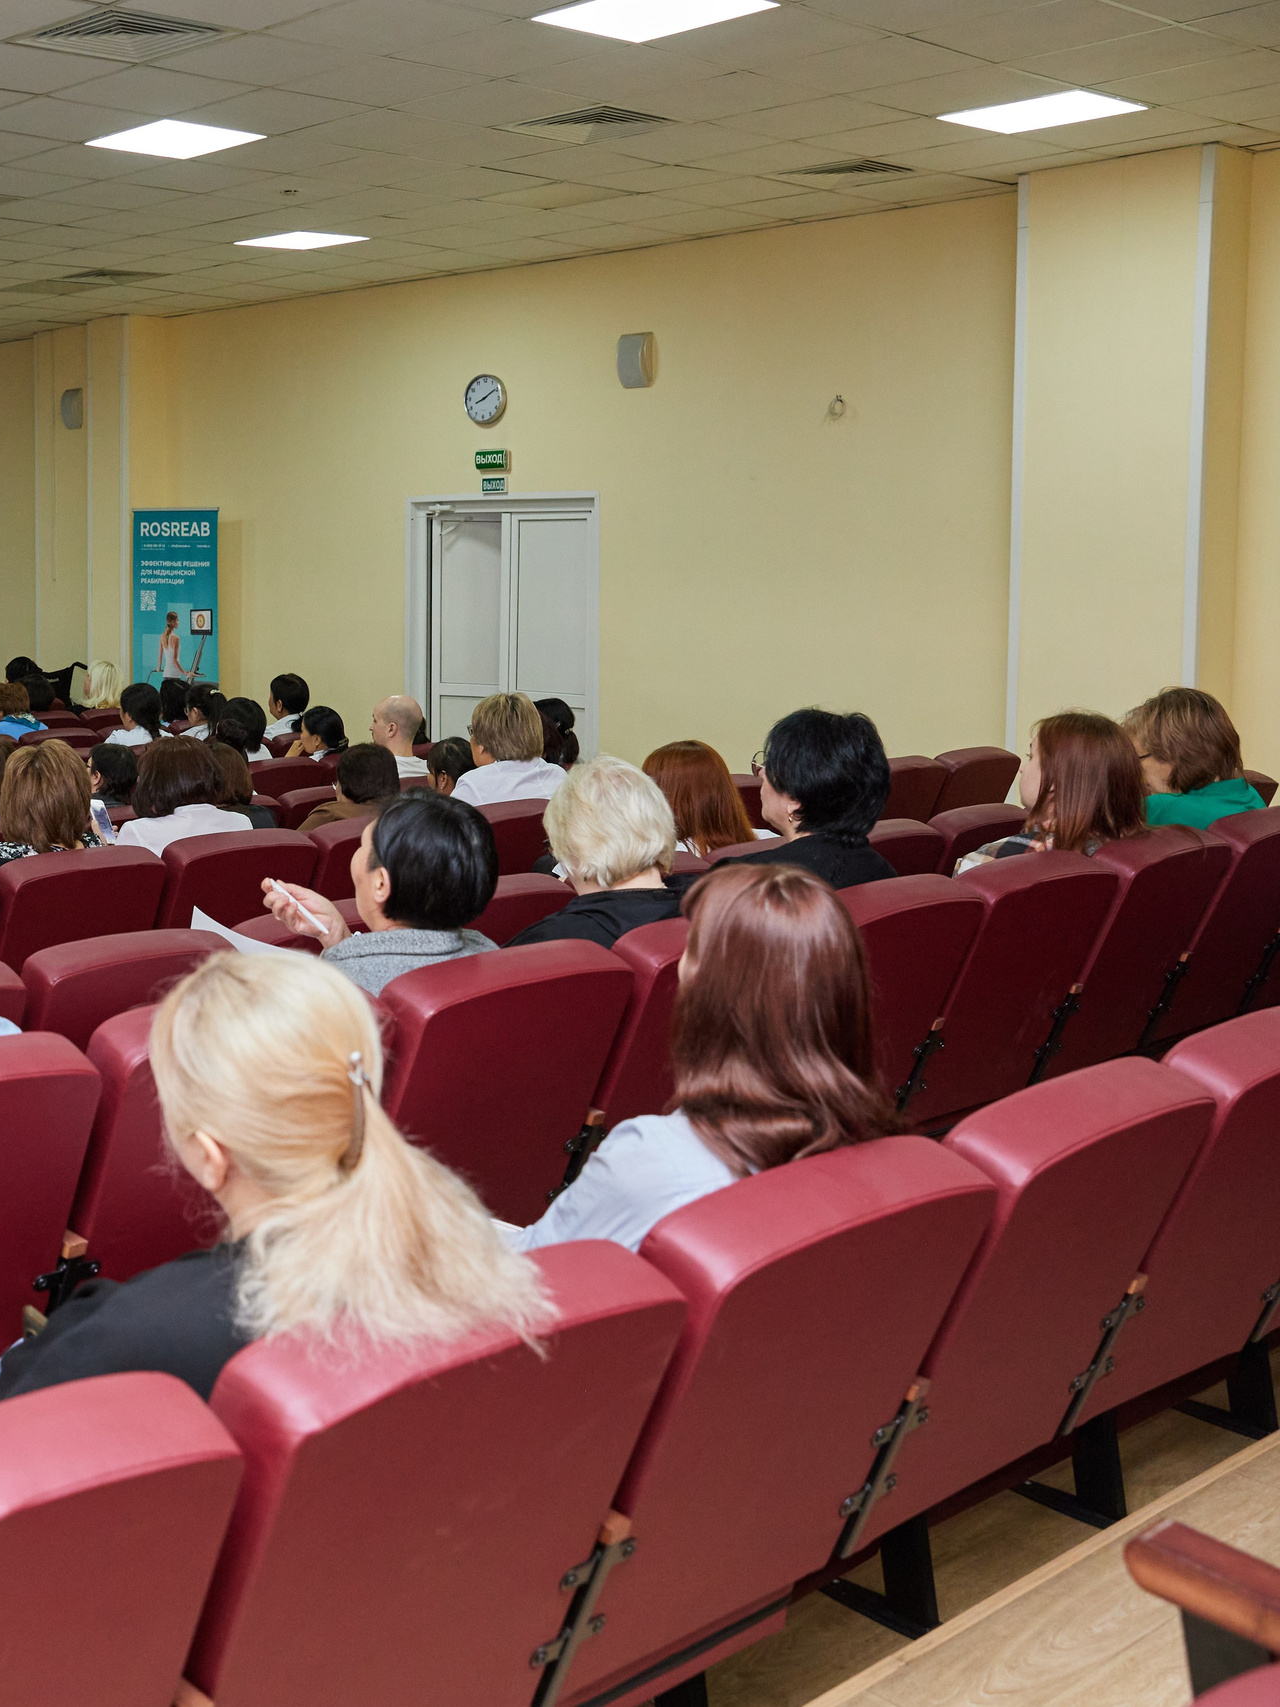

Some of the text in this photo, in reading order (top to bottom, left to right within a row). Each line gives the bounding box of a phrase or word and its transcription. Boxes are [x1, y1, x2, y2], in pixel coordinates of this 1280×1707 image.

[476, 454, 502, 464] ВЫХОД
[483, 480, 504, 490] ВЫХОД
[140, 522, 210, 537] ROSREAB
